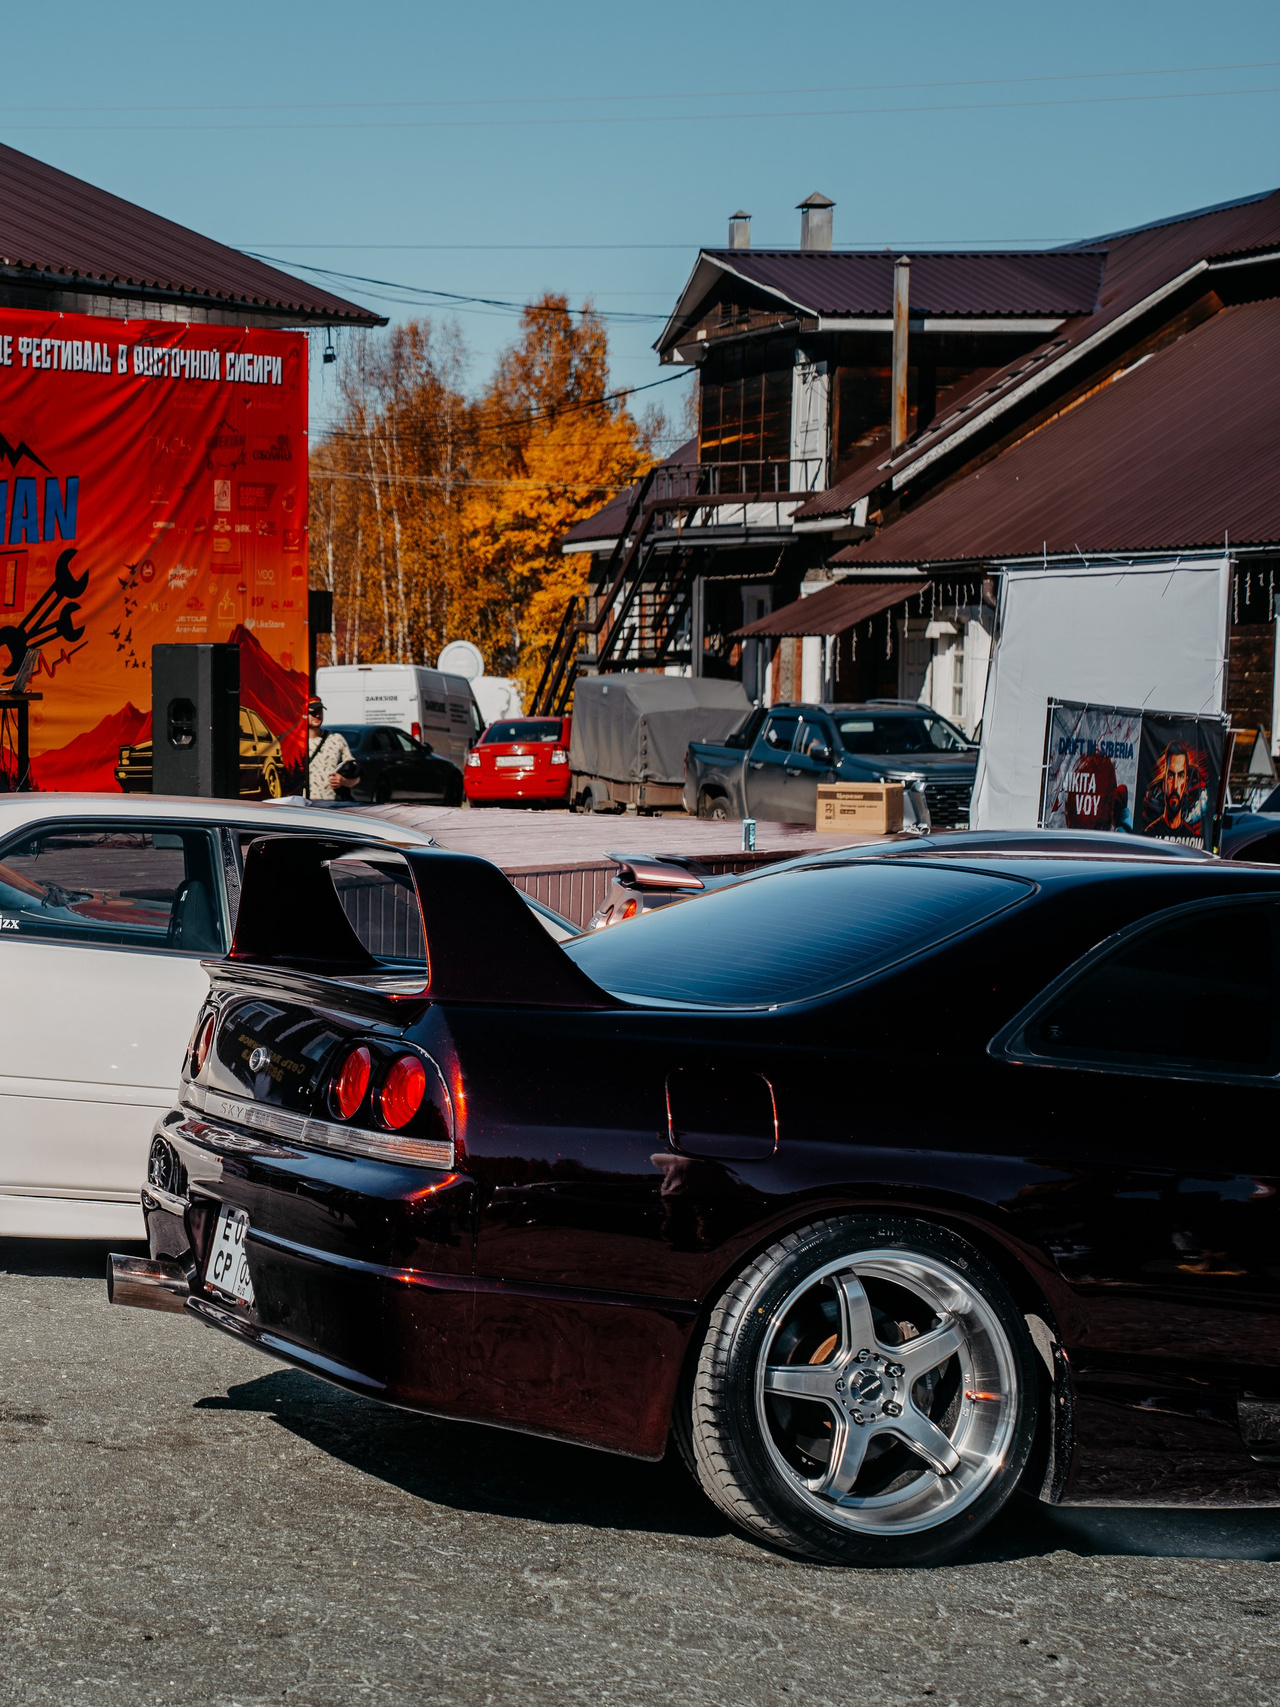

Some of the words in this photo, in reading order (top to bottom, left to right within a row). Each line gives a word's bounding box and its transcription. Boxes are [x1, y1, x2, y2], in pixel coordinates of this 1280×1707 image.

[18, 336, 112, 374] ФЕСТИВАЛЬ
[117, 344, 128, 375] В
[133, 346, 220, 381] ВОСТОЧНОЙ
[225, 352, 283, 385] СИБИРИ
[1058, 736, 1085, 756] DRIFT
[1099, 739, 1134, 760] SIBERIA
[1075, 793, 1101, 816] VOY
